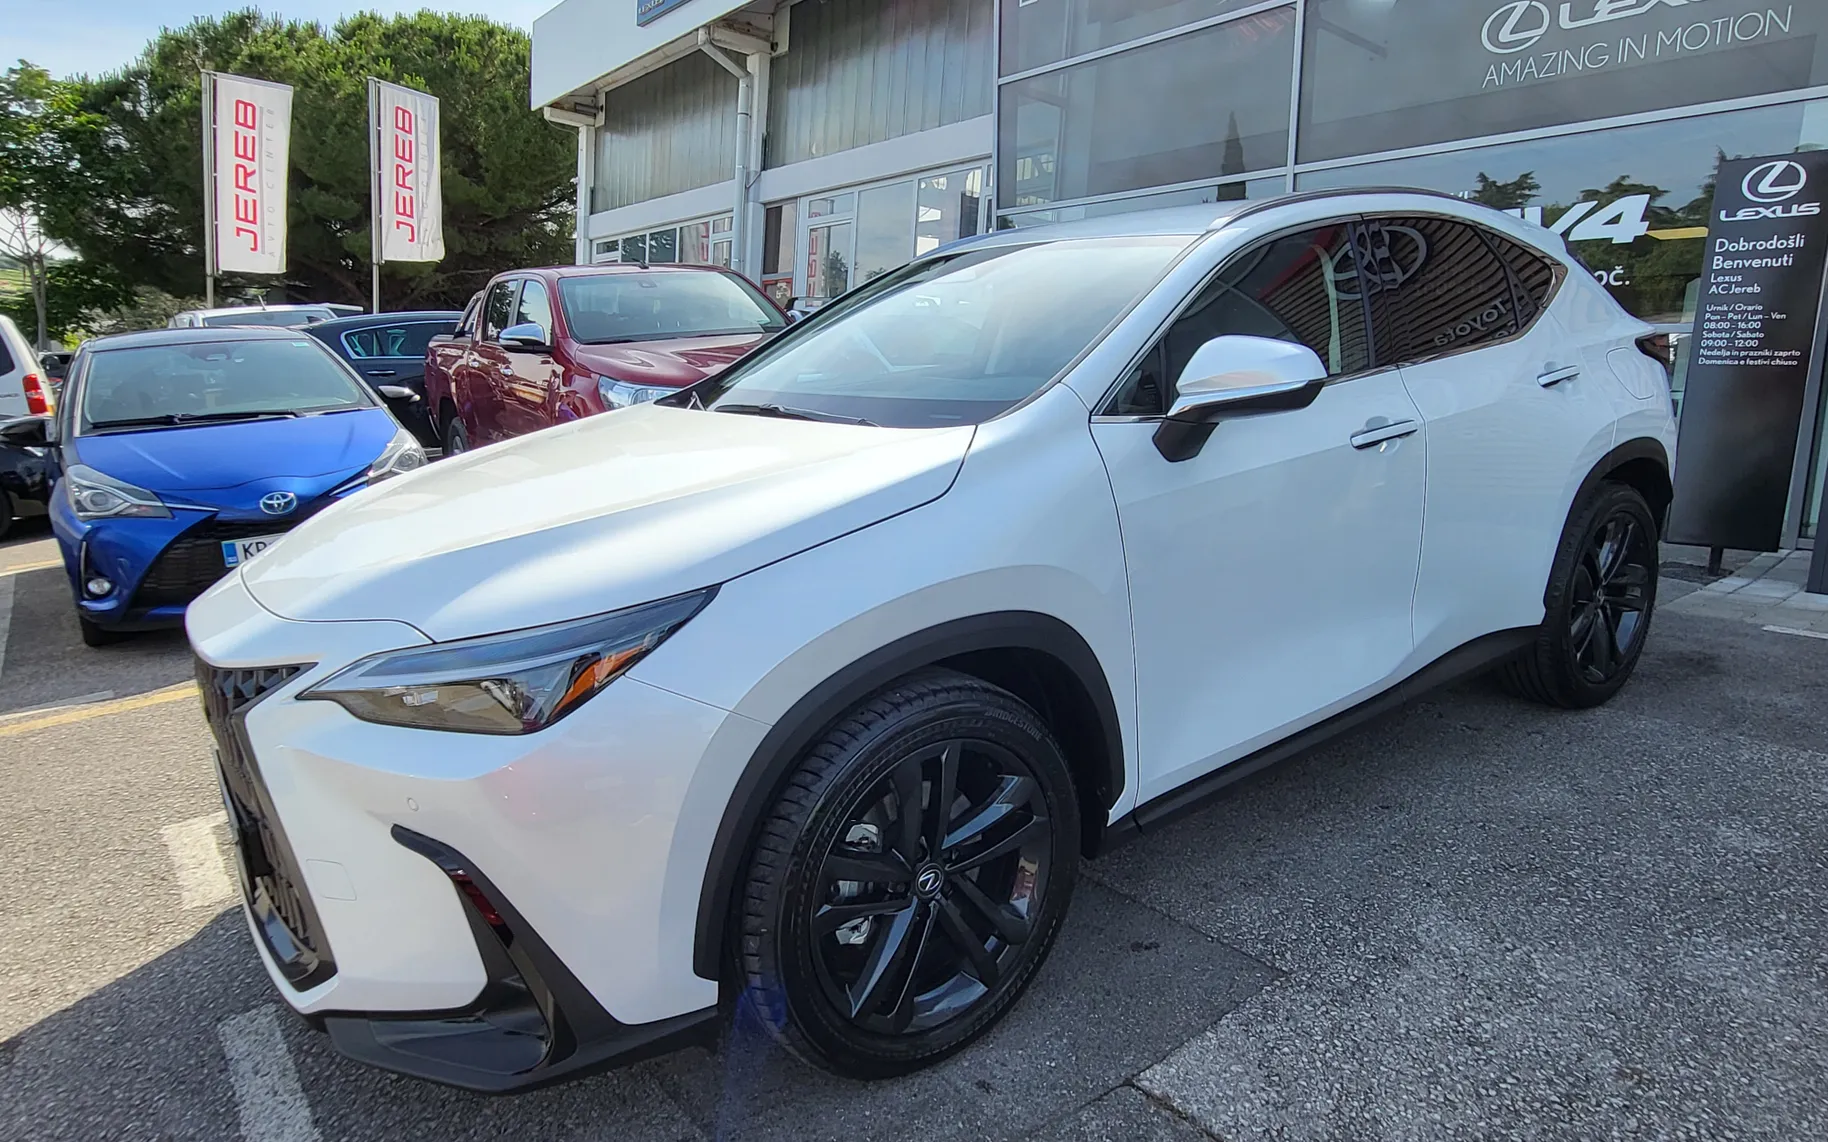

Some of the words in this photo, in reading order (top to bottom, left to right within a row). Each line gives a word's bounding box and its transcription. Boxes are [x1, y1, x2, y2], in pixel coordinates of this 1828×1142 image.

[1559, 0, 1707, 29] LEX
[1482, 43, 1609, 89] AMAZING
[1617, 34, 1647, 64] IN
[1655, 5, 1793, 56] MOTION
[234, 99, 259, 252] JEREB
[394, 105, 416, 242] JEREB
[1719, 202, 1821, 221] LEXUS
[1715, 233, 1805, 252] Dobrodošli
[1712, 253, 1794, 270] Benvenuti
[1710, 273, 1743, 283] Lexus
[1735, 303, 1763, 311] Orario
[1727, 312, 1741, 320] Pet
[1770, 312, 1787, 320] Ven
[1703, 321, 1730, 329] 08:00
[1737, 321, 1761, 329] 16:00
[1702, 330, 1730, 338] Sobota
[1701, 339, 1727, 347] 09:00
[1734, 339, 1759, 347] 12:00
[1699, 349, 1731, 357] Nedelja
[1739, 349, 1773, 357] prazniki
[1773, 349, 1801, 357] zaprto
[1698, 357, 1739, 365] Domenica
